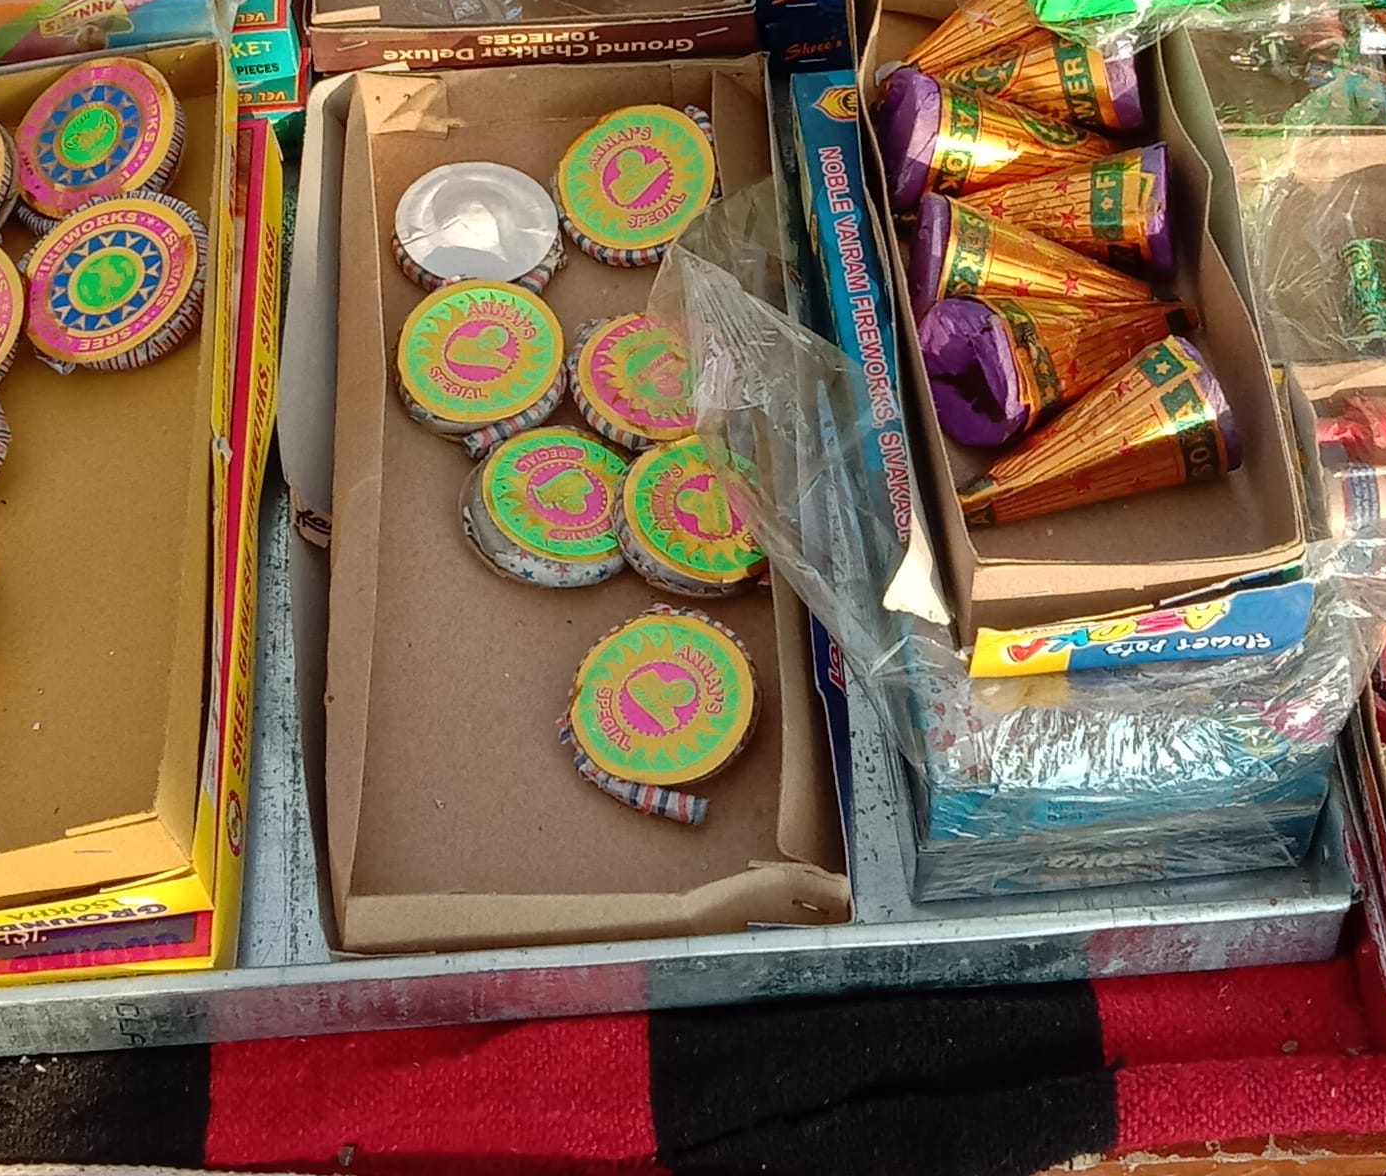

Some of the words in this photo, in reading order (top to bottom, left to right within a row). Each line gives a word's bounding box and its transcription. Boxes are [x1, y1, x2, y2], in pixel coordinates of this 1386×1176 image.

[236, 63, 280, 75] PIECES
[382, 45, 474, 65] Deluxe
[481, 42, 590, 63] Chakkar
[595, 35, 694, 55] Ground
[817, 145, 853, 215] NOBLE
[835, 215, 872, 294] VAIRAM
[849, 295, 896, 430] FIREWORKS,
[877, 431, 915, 542] SIVAKASI.
[237, 562, 254, 680] GANESH
[673, 640, 724, 717] ANNAI'S
[230, 683, 250, 778] SREE
[593, 685, 633, 756] SPECIAL
